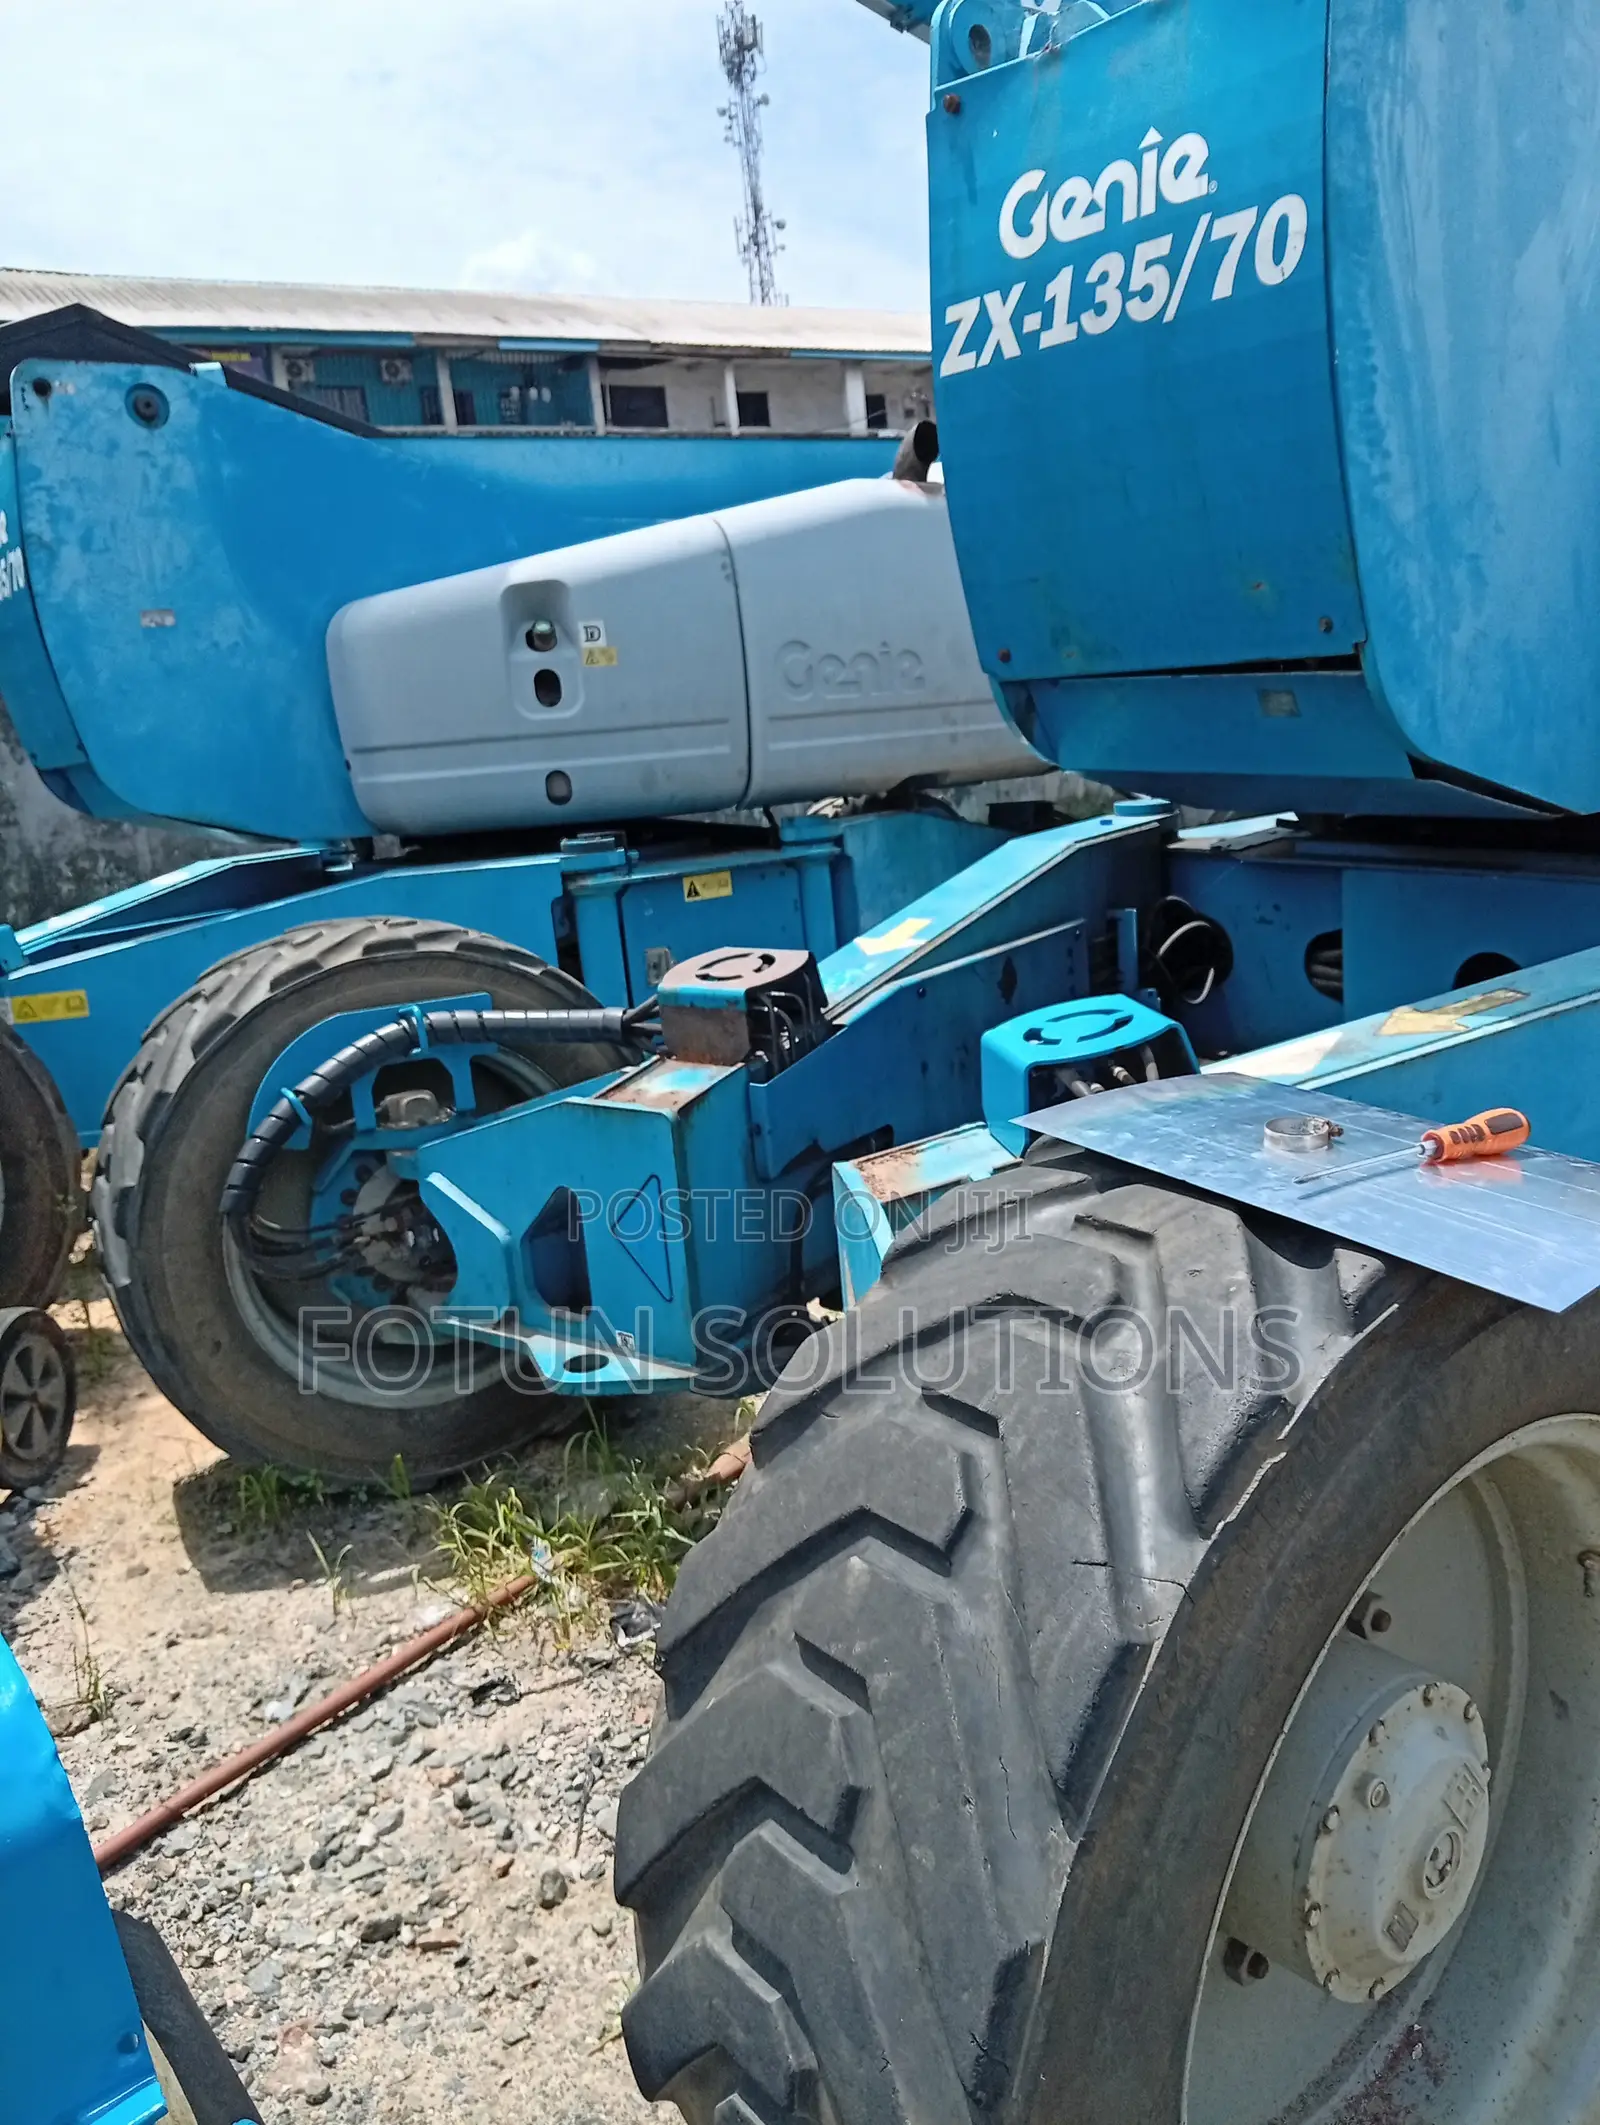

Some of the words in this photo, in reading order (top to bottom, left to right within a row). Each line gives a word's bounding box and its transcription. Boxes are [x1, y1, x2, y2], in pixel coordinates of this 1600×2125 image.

[999, 126, 1209, 259] Genie
[940, 194, 1308, 378] ZX-135/70
[774, 640, 926, 701] Genie
